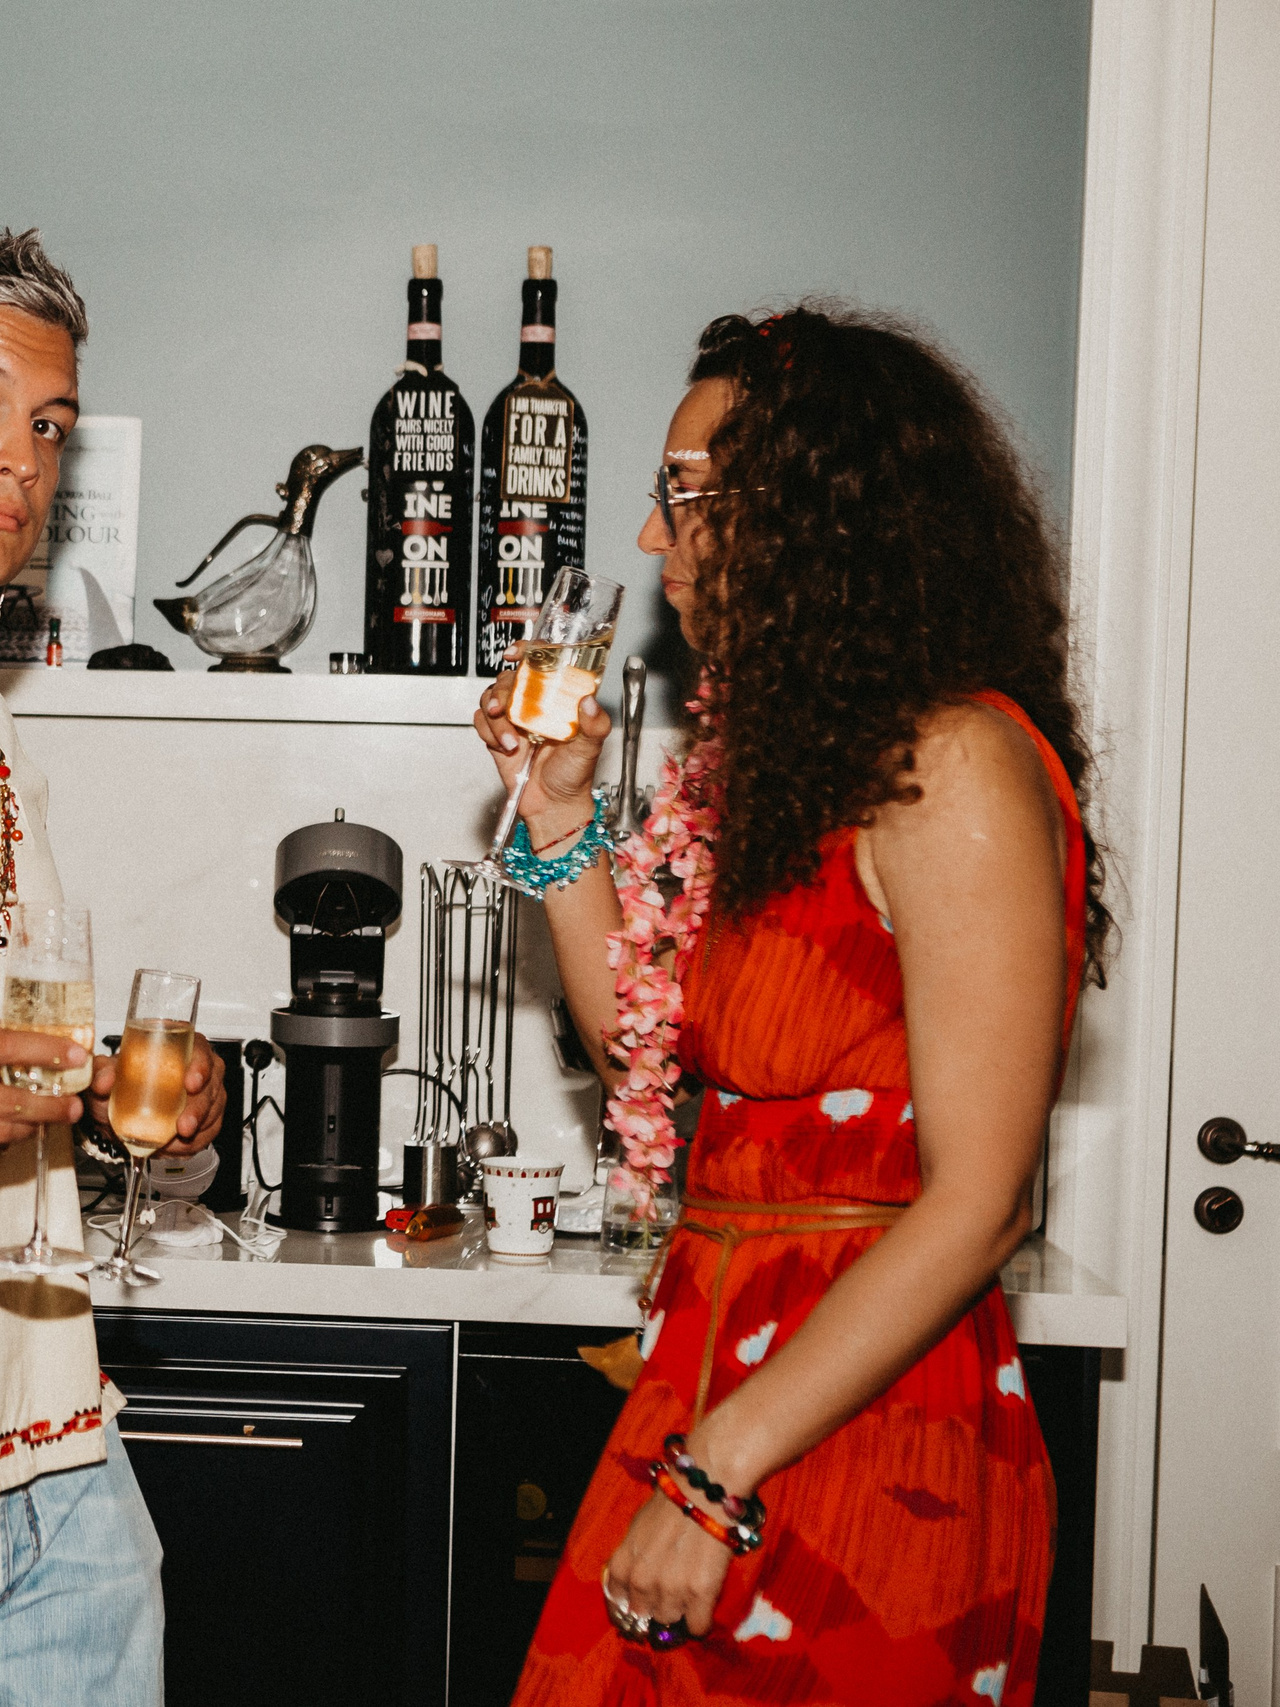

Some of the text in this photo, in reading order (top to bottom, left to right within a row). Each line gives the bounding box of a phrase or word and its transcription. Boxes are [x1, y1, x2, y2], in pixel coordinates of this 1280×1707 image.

[396, 390, 455, 419] WINE
[511, 397, 568, 417] I AM THANKFUL
[395, 418, 455, 434] PAIRS NICELY
[509, 413, 547, 446] FOR
[554, 416, 567, 448] A
[395, 434, 424, 451] WITH
[426, 435, 455, 452] GOOD
[393, 452, 454, 472] FRIENDS
[508, 445, 543, 466] FAMILY
[543, 447, 567, 468] THAT
[506, 464, 567, 499] DRINKS
[52, 504, 96, 521] ING
[43, 525, 123, 545] OLOUR
[402, 534, 448, 561] ON
[498, 535, 543, 561] ON
